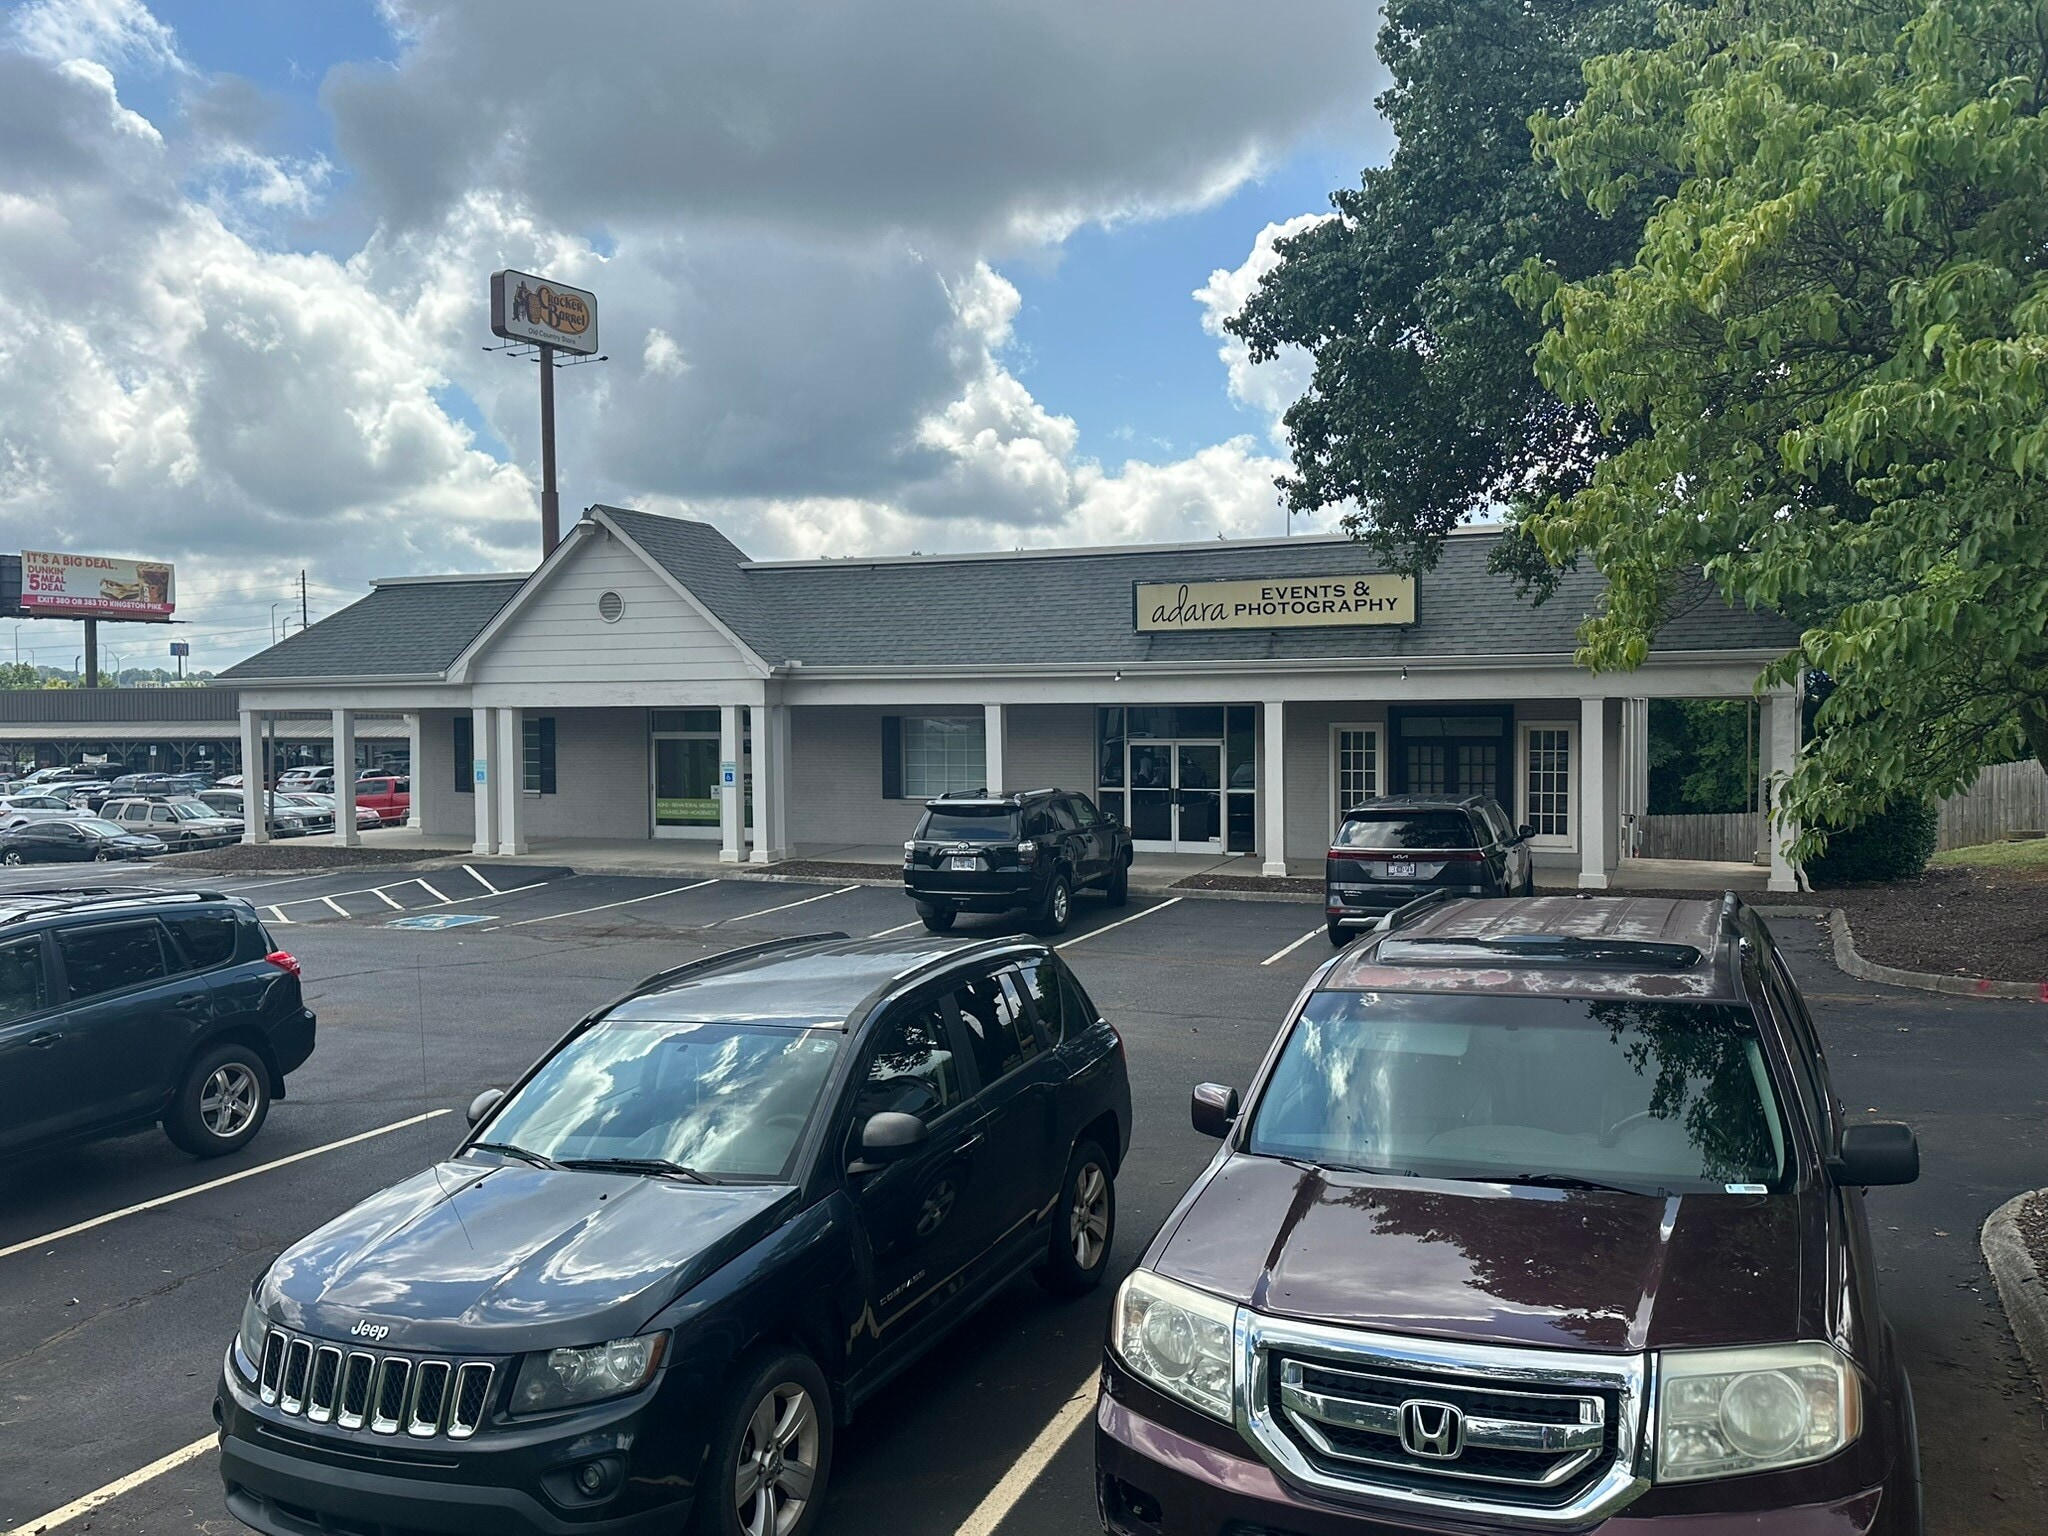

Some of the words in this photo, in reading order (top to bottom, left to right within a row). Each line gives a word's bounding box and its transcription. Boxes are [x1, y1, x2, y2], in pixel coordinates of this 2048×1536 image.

[538, 287, 583, 313] Cracker
[548, 305, 585, 328] Barrel
[528, 327, 538, 336] Old
[539, 330, 561, 342] Country
[562, 336, 576, 345] Store
[27, 552, 49, 565] IT'S
[52, 555, 60, 565] A
[63, 556, 83, 567] BIG
[86, 558, 118, 571] DEAL.
[28, 565, 66, 575] DUNKIN'
[41, 575, 67, 584] MEAL
[41, 583, 66, 592] DEAL
[1261, 584, 1347, 600] EVENTS
[1353, 581, 1370, 597] &
[37, 596, 54, 604] EXIT
[56, 596, 70, 605] 380
[72, 597, 83, 605] OR
[98, 599, 108, 607] TO
[109, 600, 146, 609] KINGSTON
[1152, 584, 1229, 626] adara
[1234, 597, 1399, 617] PHOTOGRAPHY
[351, 1319, 389, 1341] Jeep
